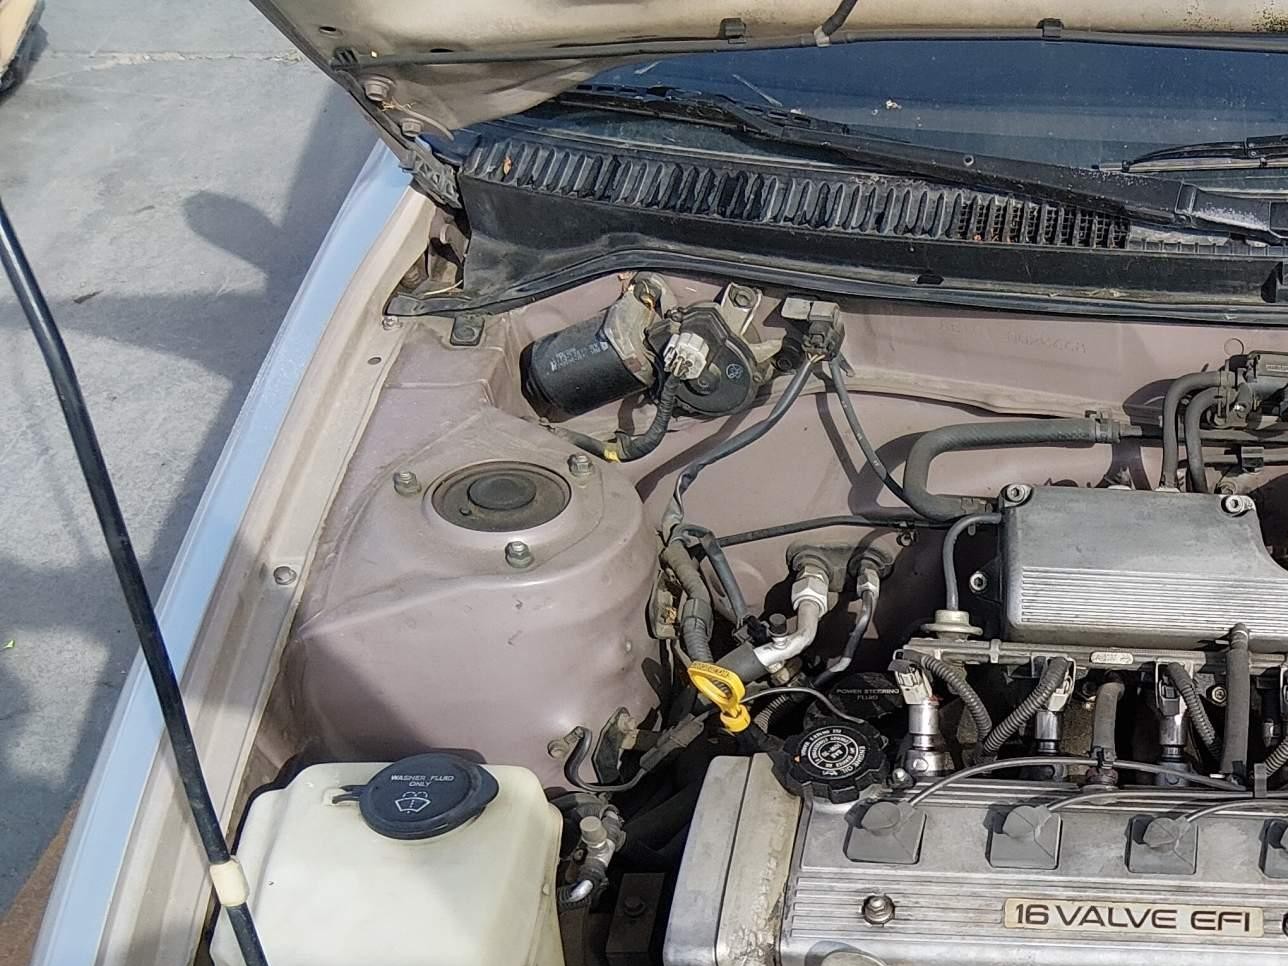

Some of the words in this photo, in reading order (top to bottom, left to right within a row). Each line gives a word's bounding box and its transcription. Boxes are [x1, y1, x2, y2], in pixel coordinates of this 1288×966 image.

[840, 765, 854, 774] OIL
[1015, 903, 1049, 925] 16
[1055, 905, 1178, 929] VALVE
[1190, 910, 1250, 932] EFI
